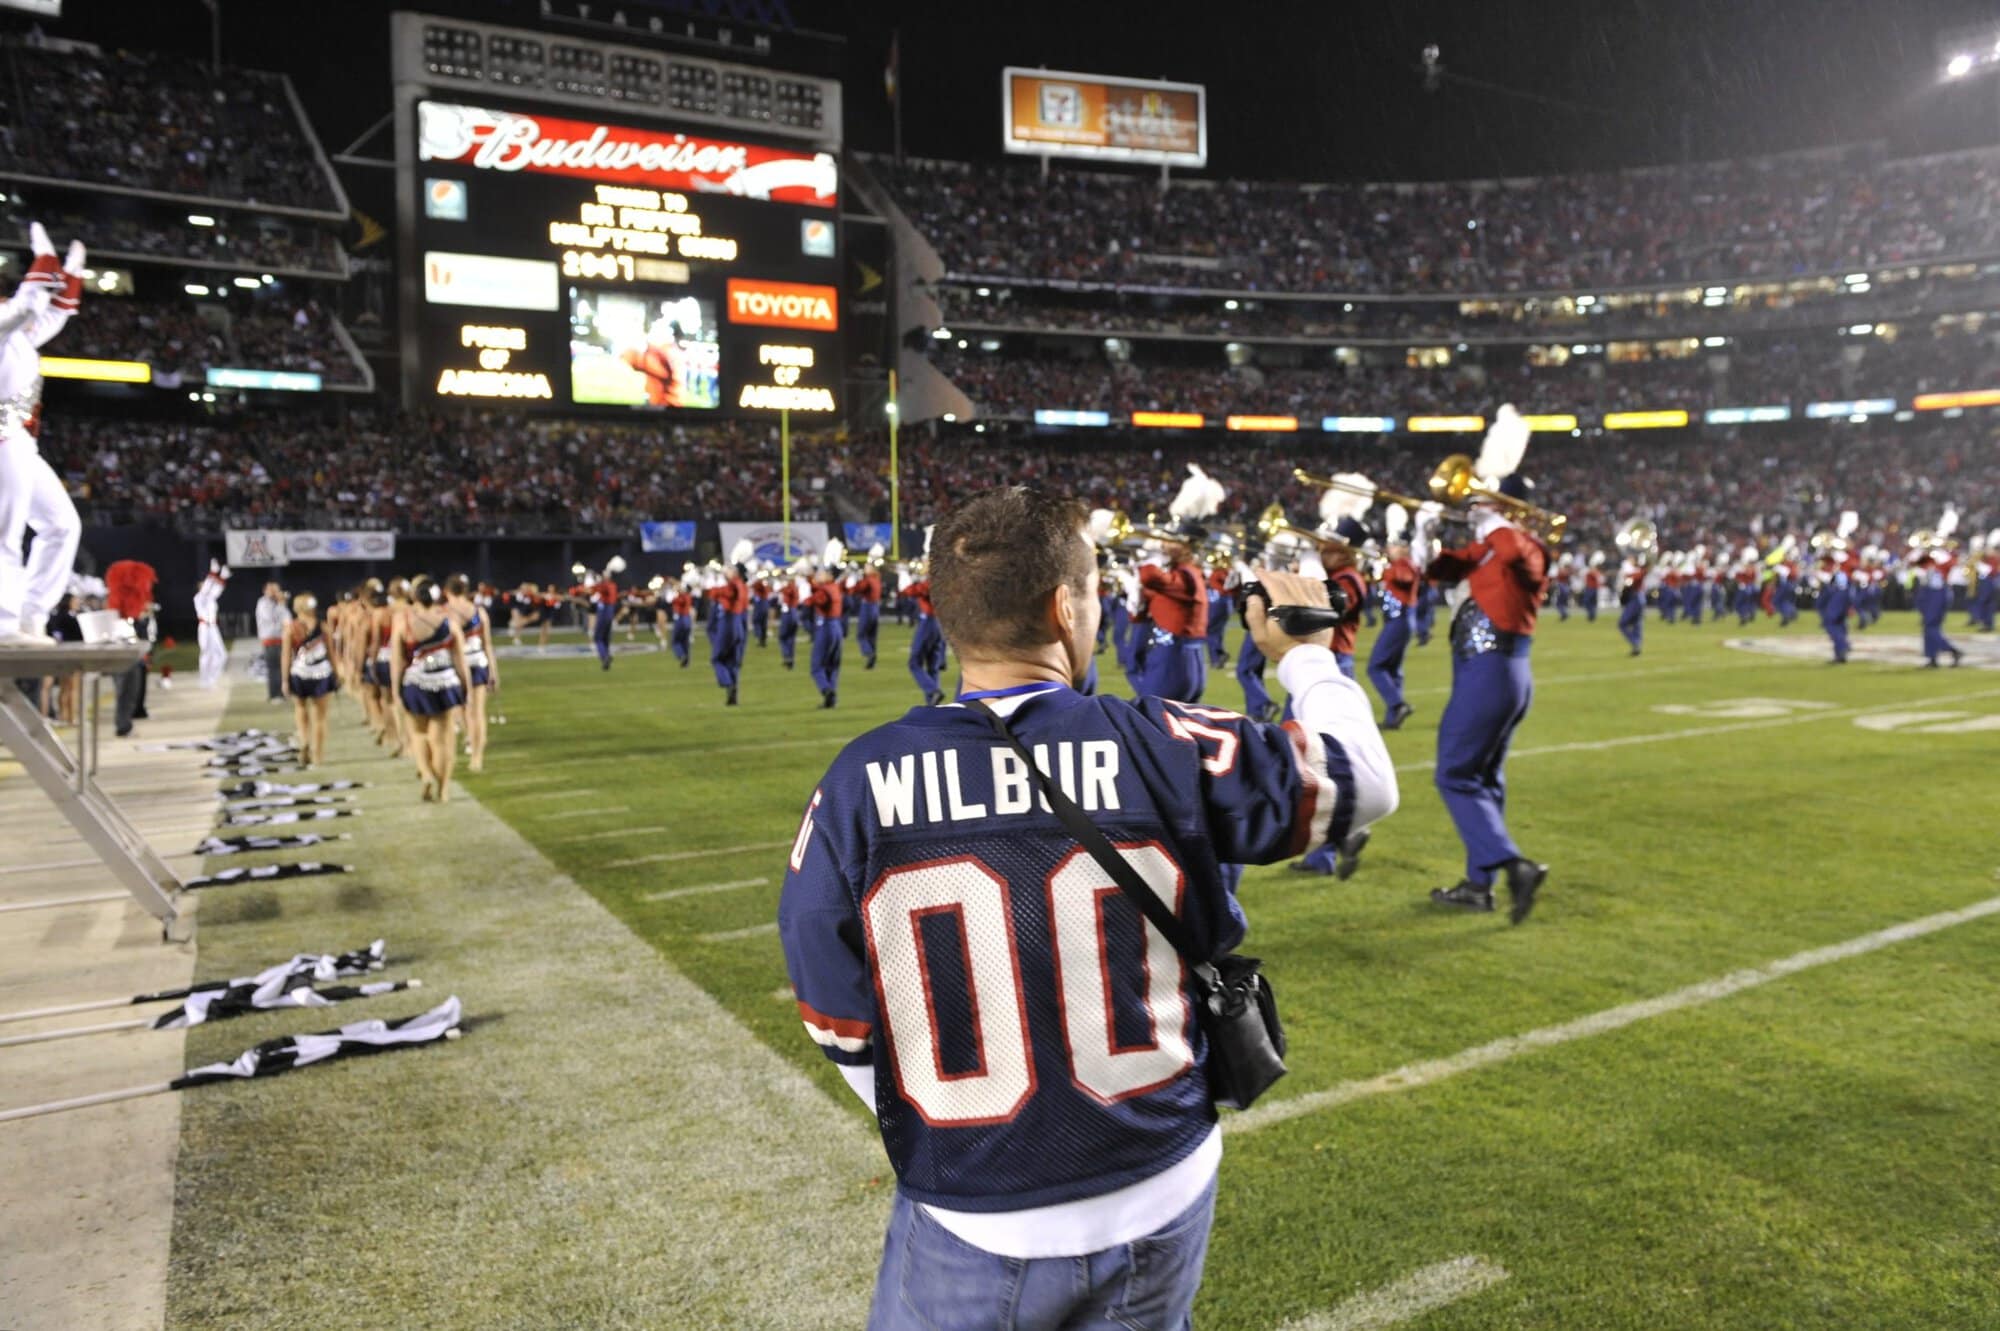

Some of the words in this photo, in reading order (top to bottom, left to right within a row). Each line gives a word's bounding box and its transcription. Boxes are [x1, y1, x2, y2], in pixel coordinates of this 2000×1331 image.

[471, 117, 746, 173] Budweiser
[733, 291, 833, 321] TOYOTA
[437, 369, 553, 399] ARIZONA
[865, 740, 1121, 828] WILBUR
[862, 839, 1194, 1128] 00
